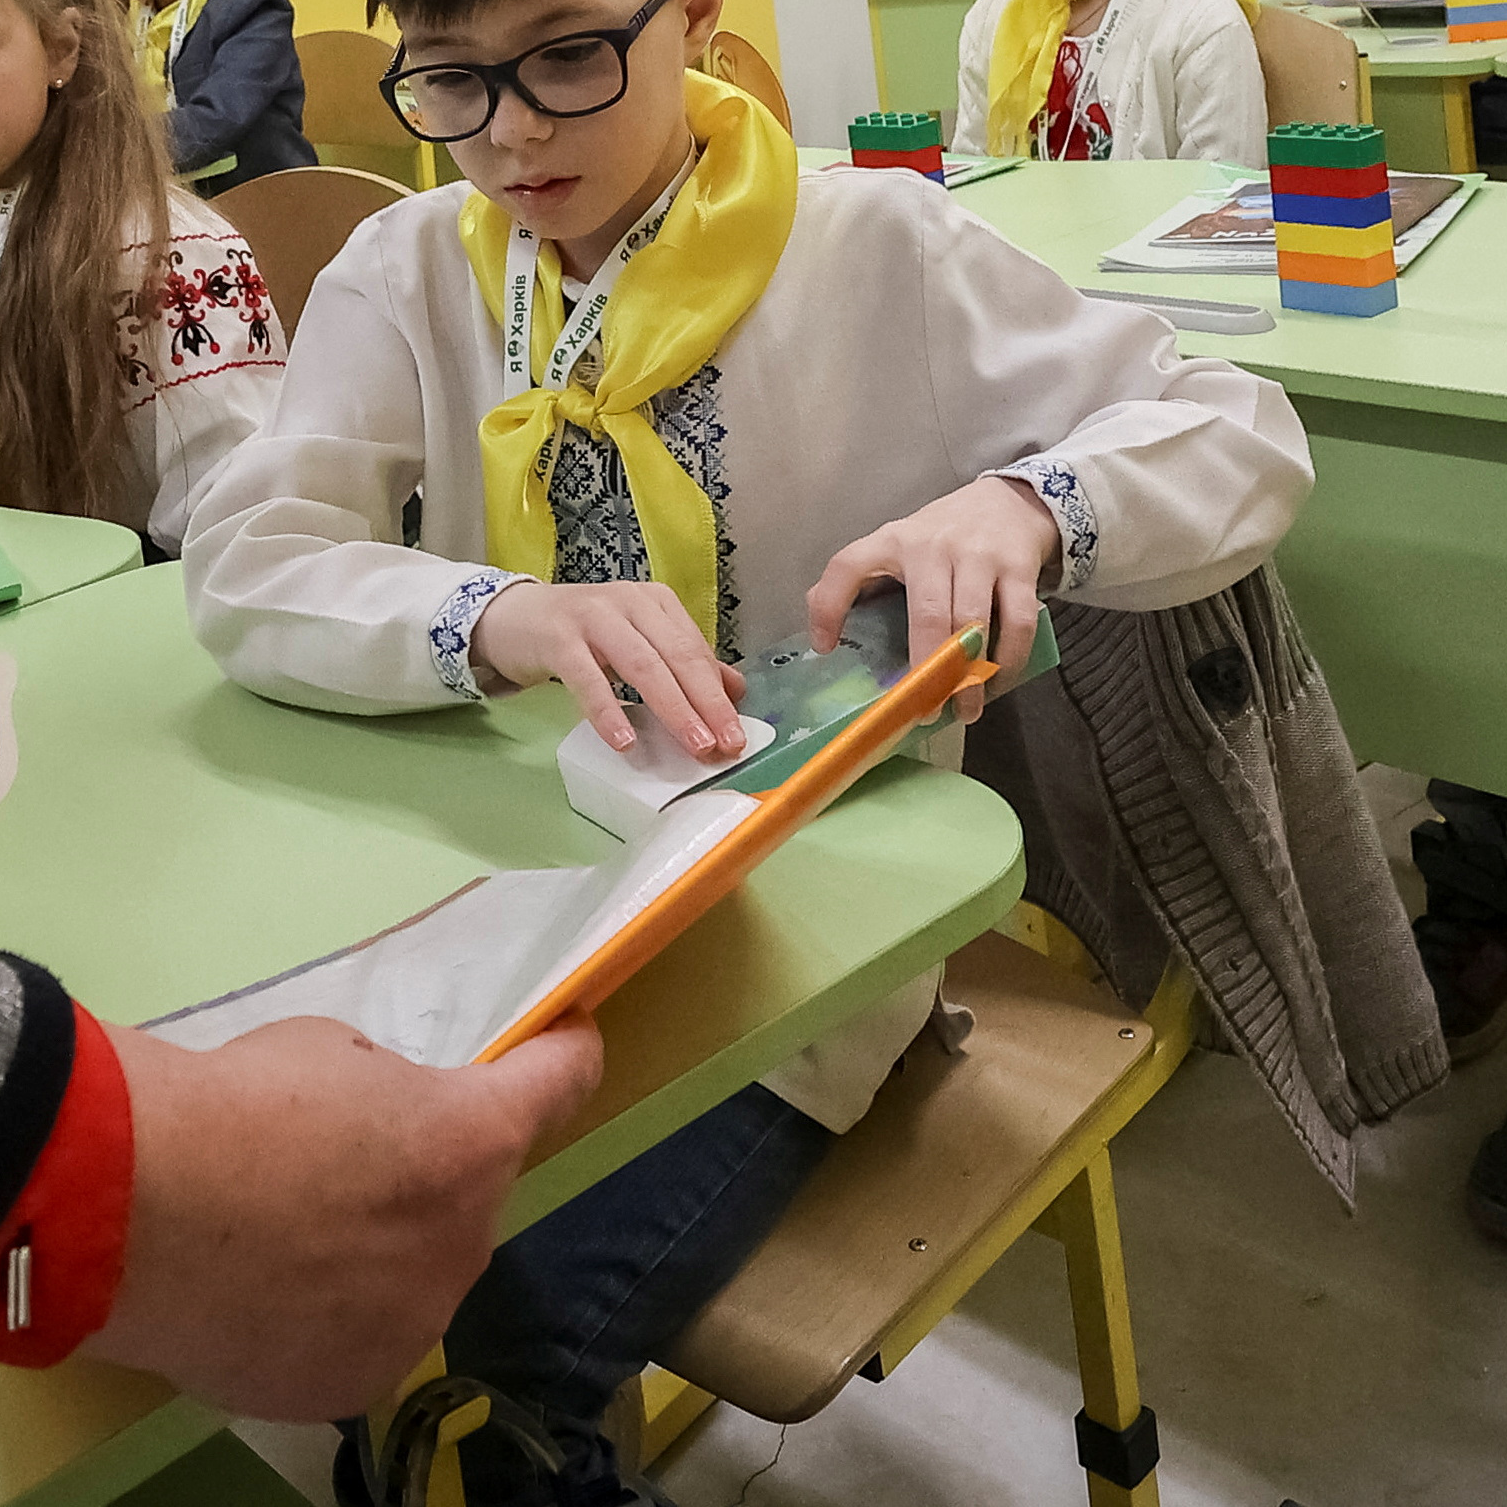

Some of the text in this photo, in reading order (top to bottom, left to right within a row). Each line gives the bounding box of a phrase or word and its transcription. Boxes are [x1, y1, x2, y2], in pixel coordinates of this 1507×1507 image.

[0, 206, 10, 216] Я
[518, 228, 534, 240] Я
[619, 248, 632, 264] Я
[510, 274, 527, 374] Я Харків
[551, 293, 609, 383] Я Харків
